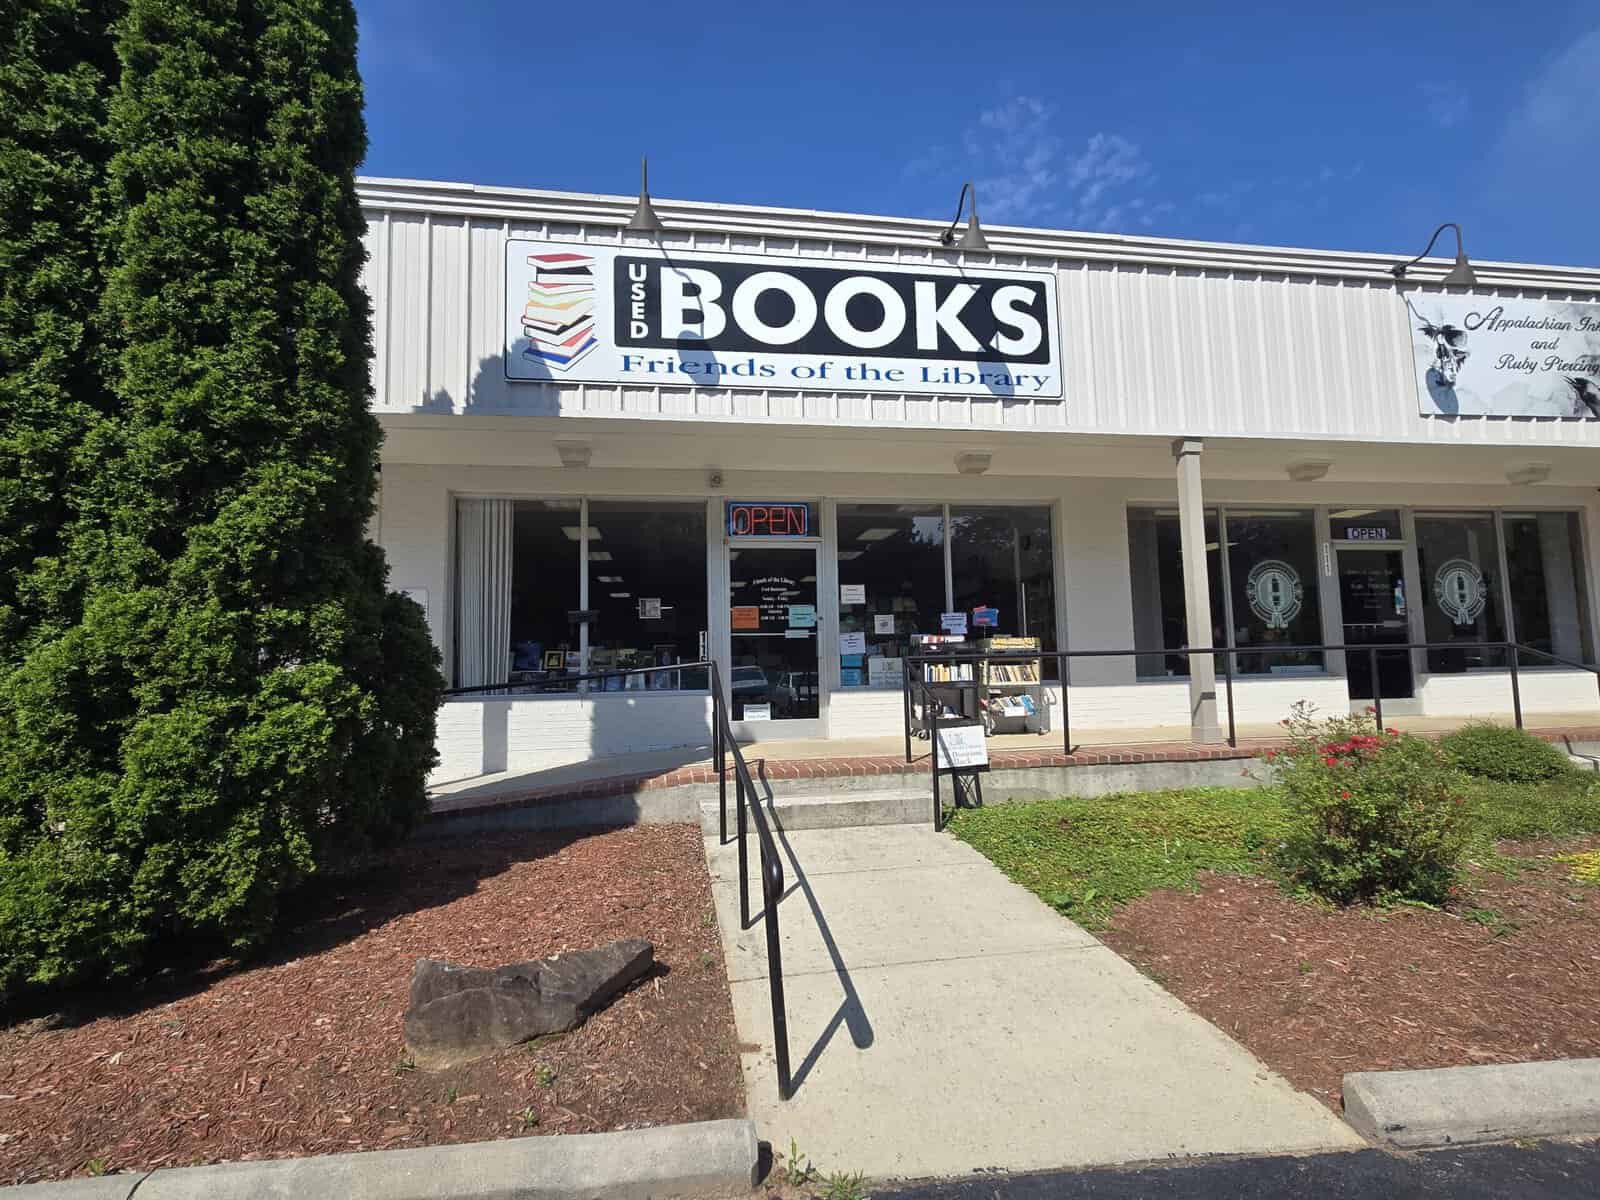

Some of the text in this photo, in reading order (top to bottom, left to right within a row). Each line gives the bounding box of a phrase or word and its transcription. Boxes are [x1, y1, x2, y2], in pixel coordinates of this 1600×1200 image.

[628, 263, 649, 339] USED
[660, 266, 1043, 356] BOOKS
[1464, 306, 1571, 332] Appalachian
[1530, 337, 1560, 350] and
[620, 354, 1051, 392] Friends of the Library
[1494, 353, 1539, 375] Ruby
[732, 506, 805, 535] OPEN
[1351, 528, 1384, 538] OPEN
